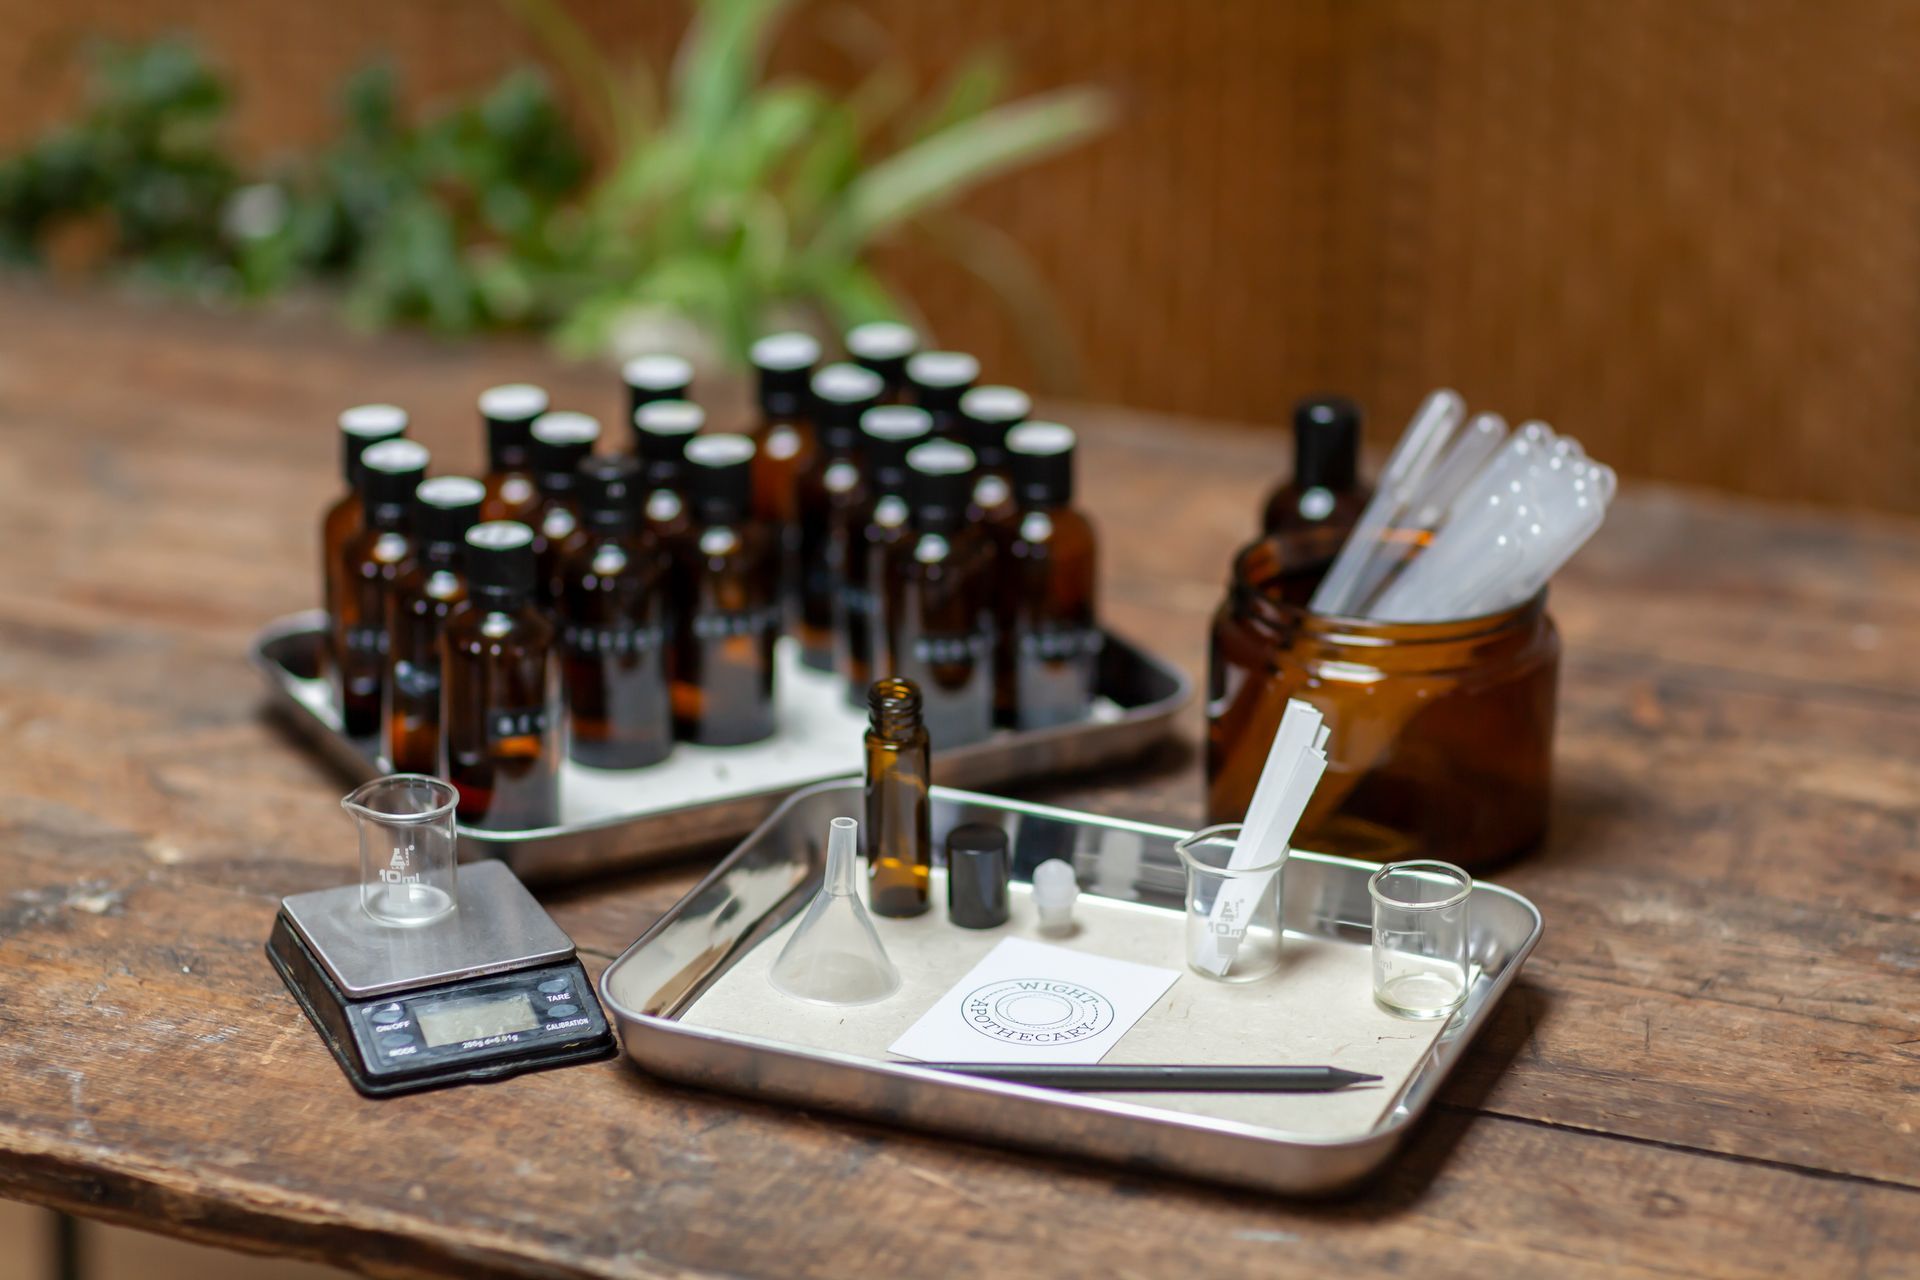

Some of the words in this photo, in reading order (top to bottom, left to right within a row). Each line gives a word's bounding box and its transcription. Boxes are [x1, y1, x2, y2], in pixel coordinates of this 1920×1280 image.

[546, 992, 571, 1003] TARE
[1017, 982, 1100, 1005] WIGHT
[545, 1018, 589, 1031] CALIBRATION
[970, 999, 1096, 1042] APOTHECARY
